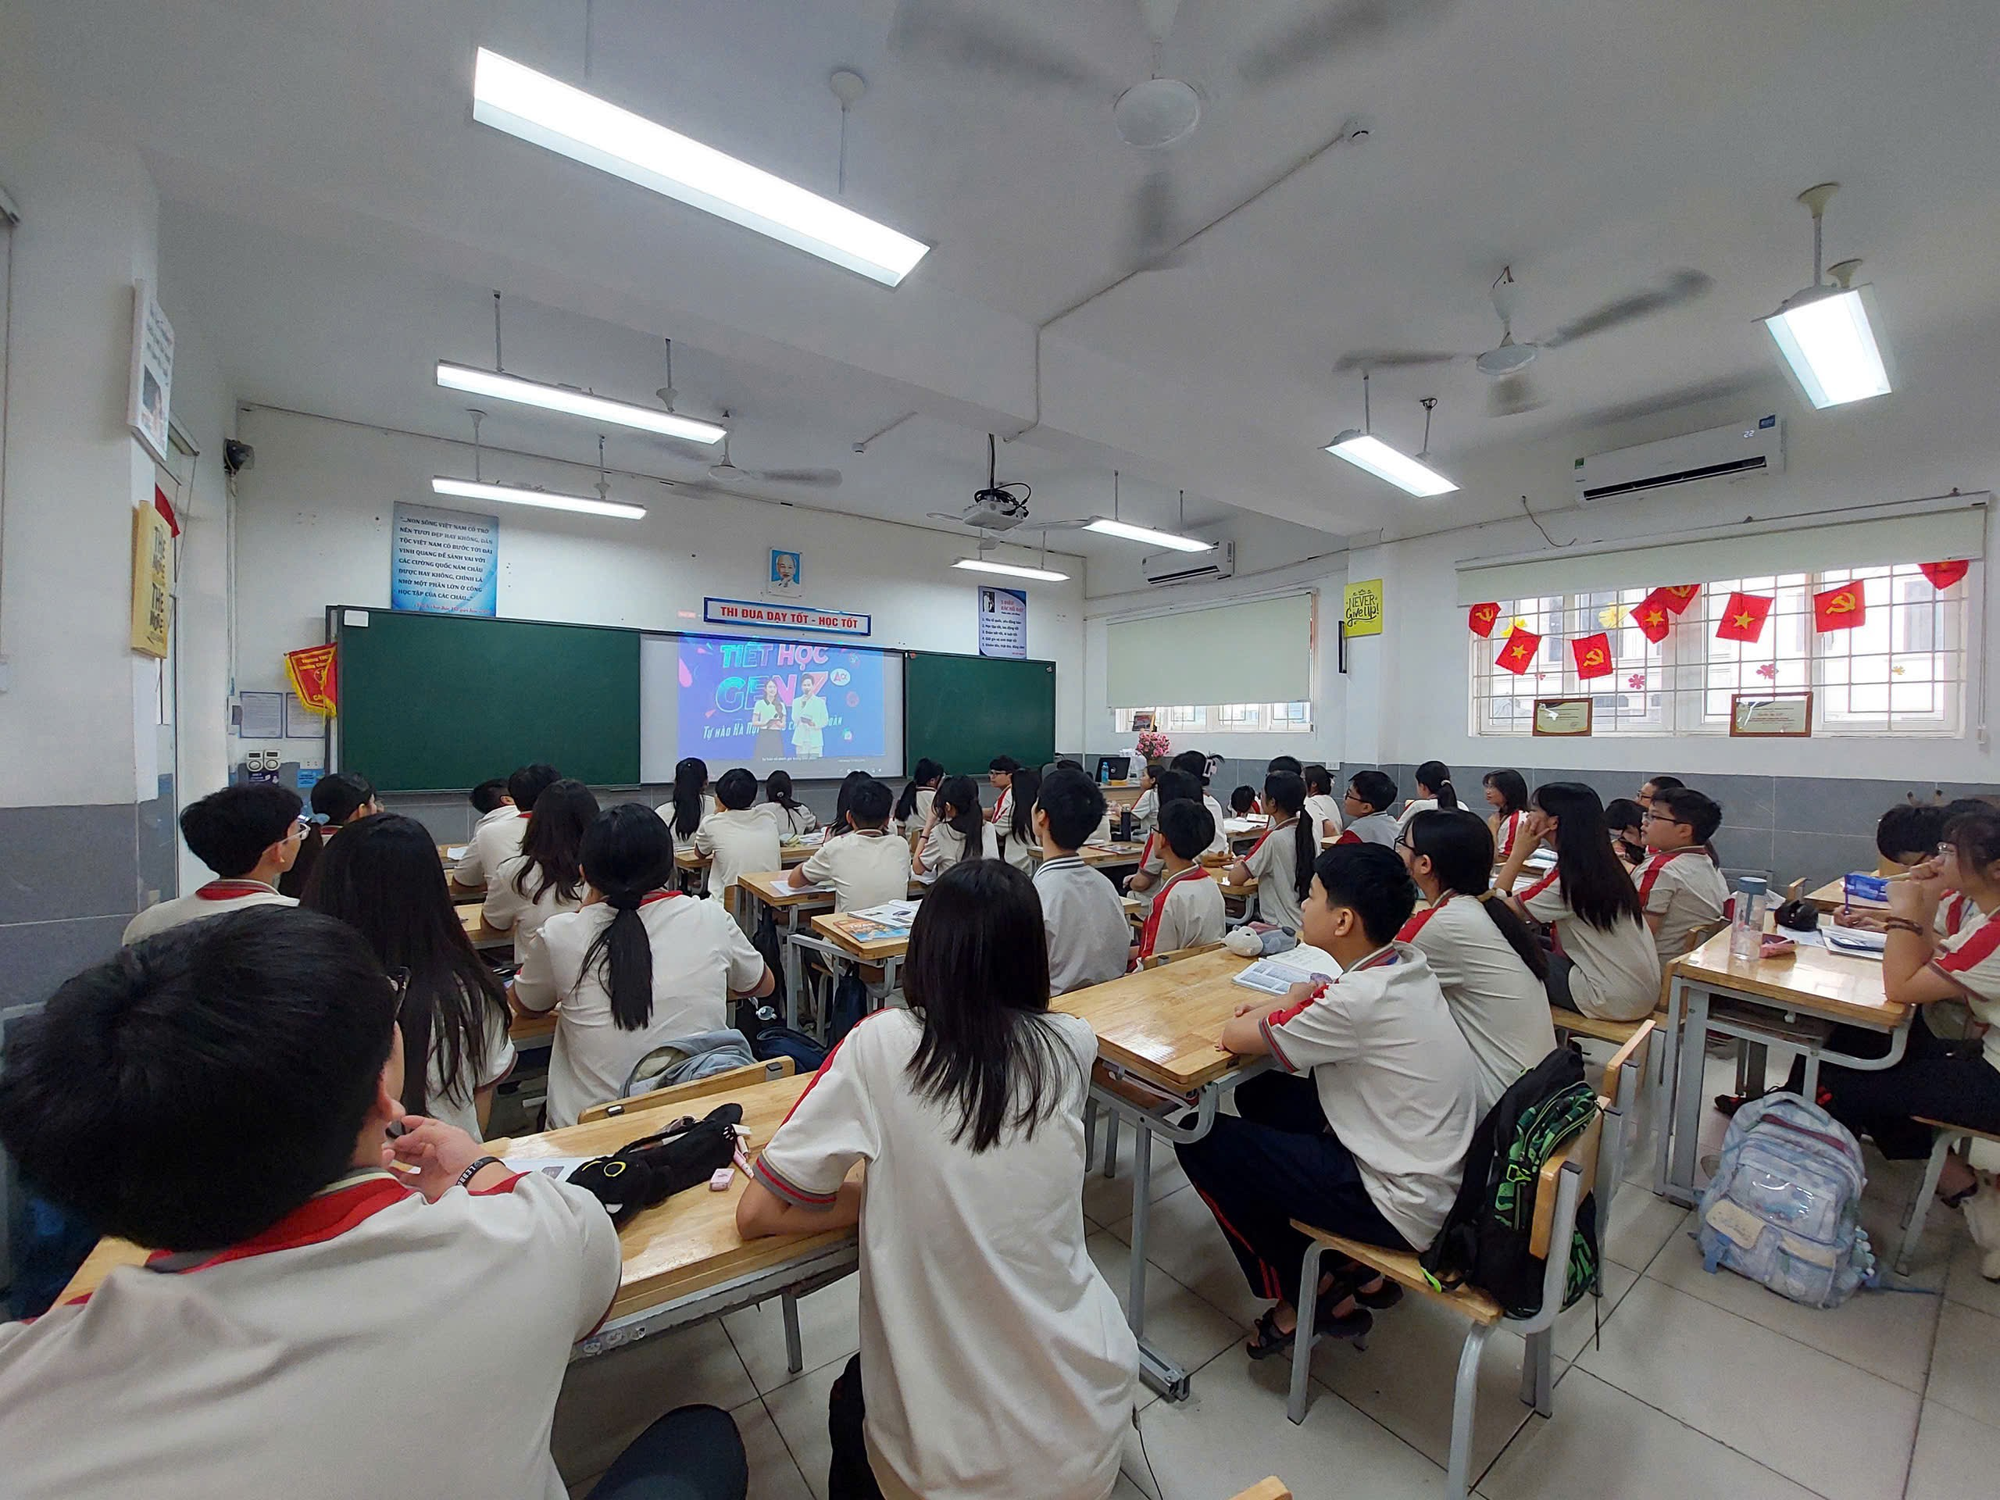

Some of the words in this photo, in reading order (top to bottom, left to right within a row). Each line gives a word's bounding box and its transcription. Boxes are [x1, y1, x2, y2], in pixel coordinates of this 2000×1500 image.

[1349, 594, 1375, 608] NEVER
[720, 606, 738, 618] THI
[741, 609, 764, 620] ĐUA
[766, 611, 788, 624] DẠY
[790, 612, 809, 624] TỐT
[818, 616, 838, 628] HỌC
[841, 616, 858, 629] TỐT
[777, 644, 829, 671] HỌC
[716, 674, 798, 712] GEN
